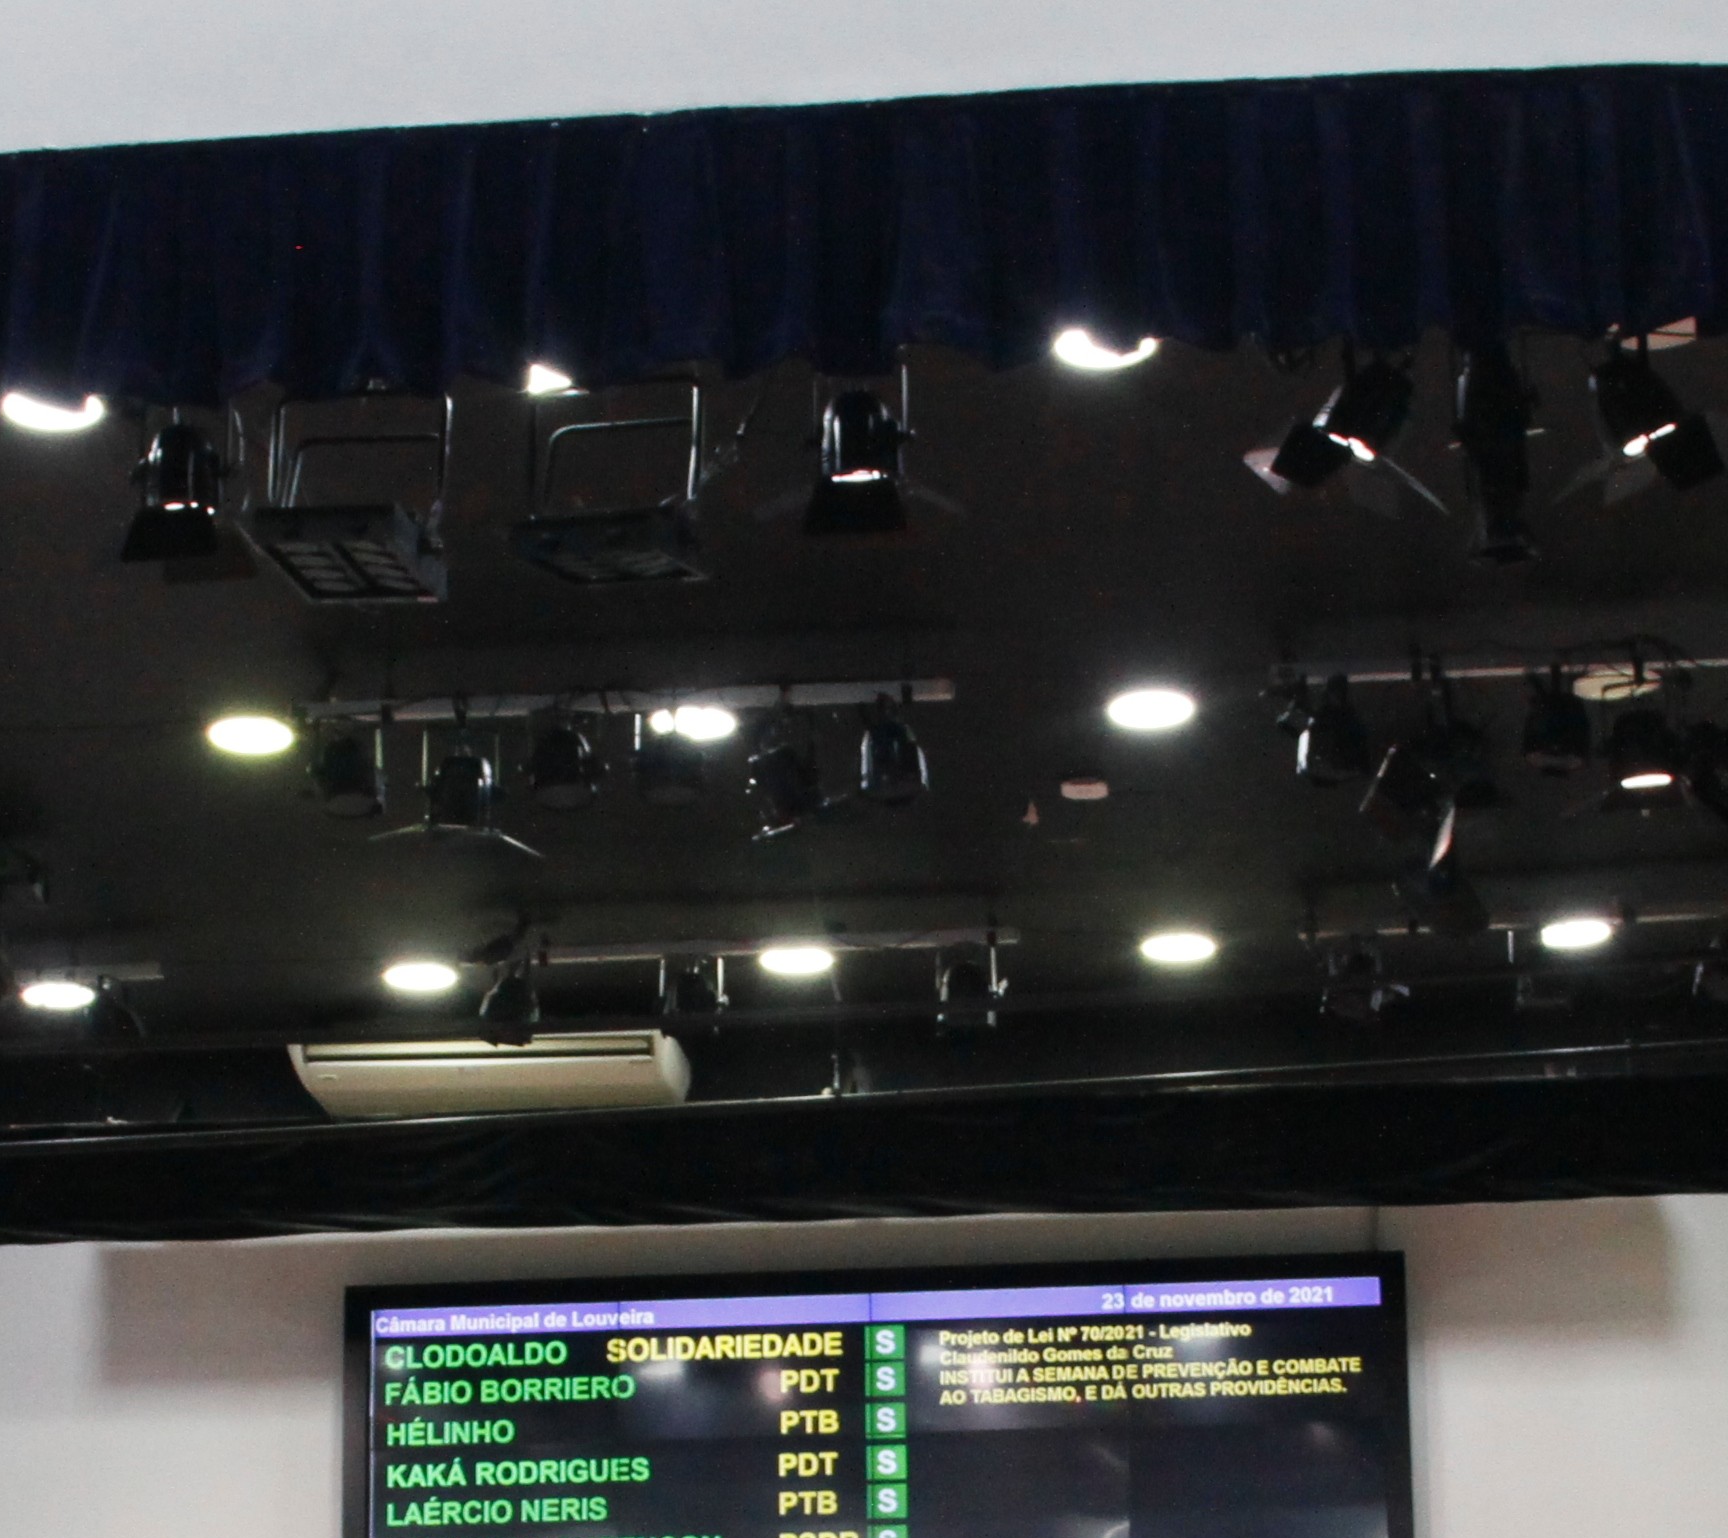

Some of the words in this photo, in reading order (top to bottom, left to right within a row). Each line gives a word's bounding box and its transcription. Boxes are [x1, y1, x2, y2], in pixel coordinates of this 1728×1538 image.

[1102, 1293, 1124, 1309] 23
[1131, 1291, 1155, 1308] de
[1160, 1289, 1255, 1307] novembro
[1261, 1288, 1285, 1305] de
[1290, 1286, 1334, 1303] 2021
[375, 1317, 445, 1333] Câmara
[451, 1313, 539, 1332] Municipal
[544, 1312, 567, 1329] de
[573, 1309, 654, 1327] Louveira
[385, 1342, 567, 1369] CLODOALDO
[607, 1333, 843, 1361] SOLIDARIEDADE
[876, 1330, 895, 1353] S
[940, 1330, 999, 1349] Projeto
[1003, 1329, 1023, 1344] de
[1028, 1328, 1053, 1344] Lei
[1081, 1325, 1143, 1342] 70/2021
[1159, 1322, 1251, 1340] Legislativo
[941, 1348, 1039, 1364] Claudenildo
[1043, 1347, 1101, 1362] Gomes
[1106, 1346, 1129, 1360] da
[1133, 1344, 1172, 1360] Cruz
[940, 1368, 1013, 1384] INSTITUI
[1016, 1367, 1030, 1383] A
[1033, 1364, 1108, 1382] SEMANA
[1113, 1364, 1136, 1380] DE
[1140, 1359, 1252, 1379] PREVENÇÃO
[1257, 1360, 1268, 1375] E
[1273, 1357, 1361, 1375] COMBATE
[385, 1375, 472, 1405] FÁBIO
[480, 1375, 635, 1402] BORRIERO
[780, 1369, 839, 1393] PDT
[877, 1368, 895, 1391] S
[940, 1389, 966, 1404] AO
[971, 1385, 1081, 1404] TABAGISMO,
[1086, 1385, 1096, 1400] E
[1101, 1381, 1127, 1399] DÁ
[1133, 1382, 1205, 1398] OUTRAS
[1210, 1376, 1347, 1397] PROVIDÊNCIAS.
[387, 1418, 515, 1446] HÉLINHO
[780, 1410, 839, 1435] PTB
[877, 1409, 896, 1431] S
[387, 1458, 466, 1488] KAKÁ
[476, 1458, 650, 1485] RODRIGUES
[779, 1452, 838, 1477] PDT
[877, 1451, 896, 1473] S
[387, 1498, 512, 1528] LAÉRCIO
[521, 1497, 607, 1522] NERIS
[779, 1492, 838, 1515] PTB
[877, 1490, 896, 1512] S
